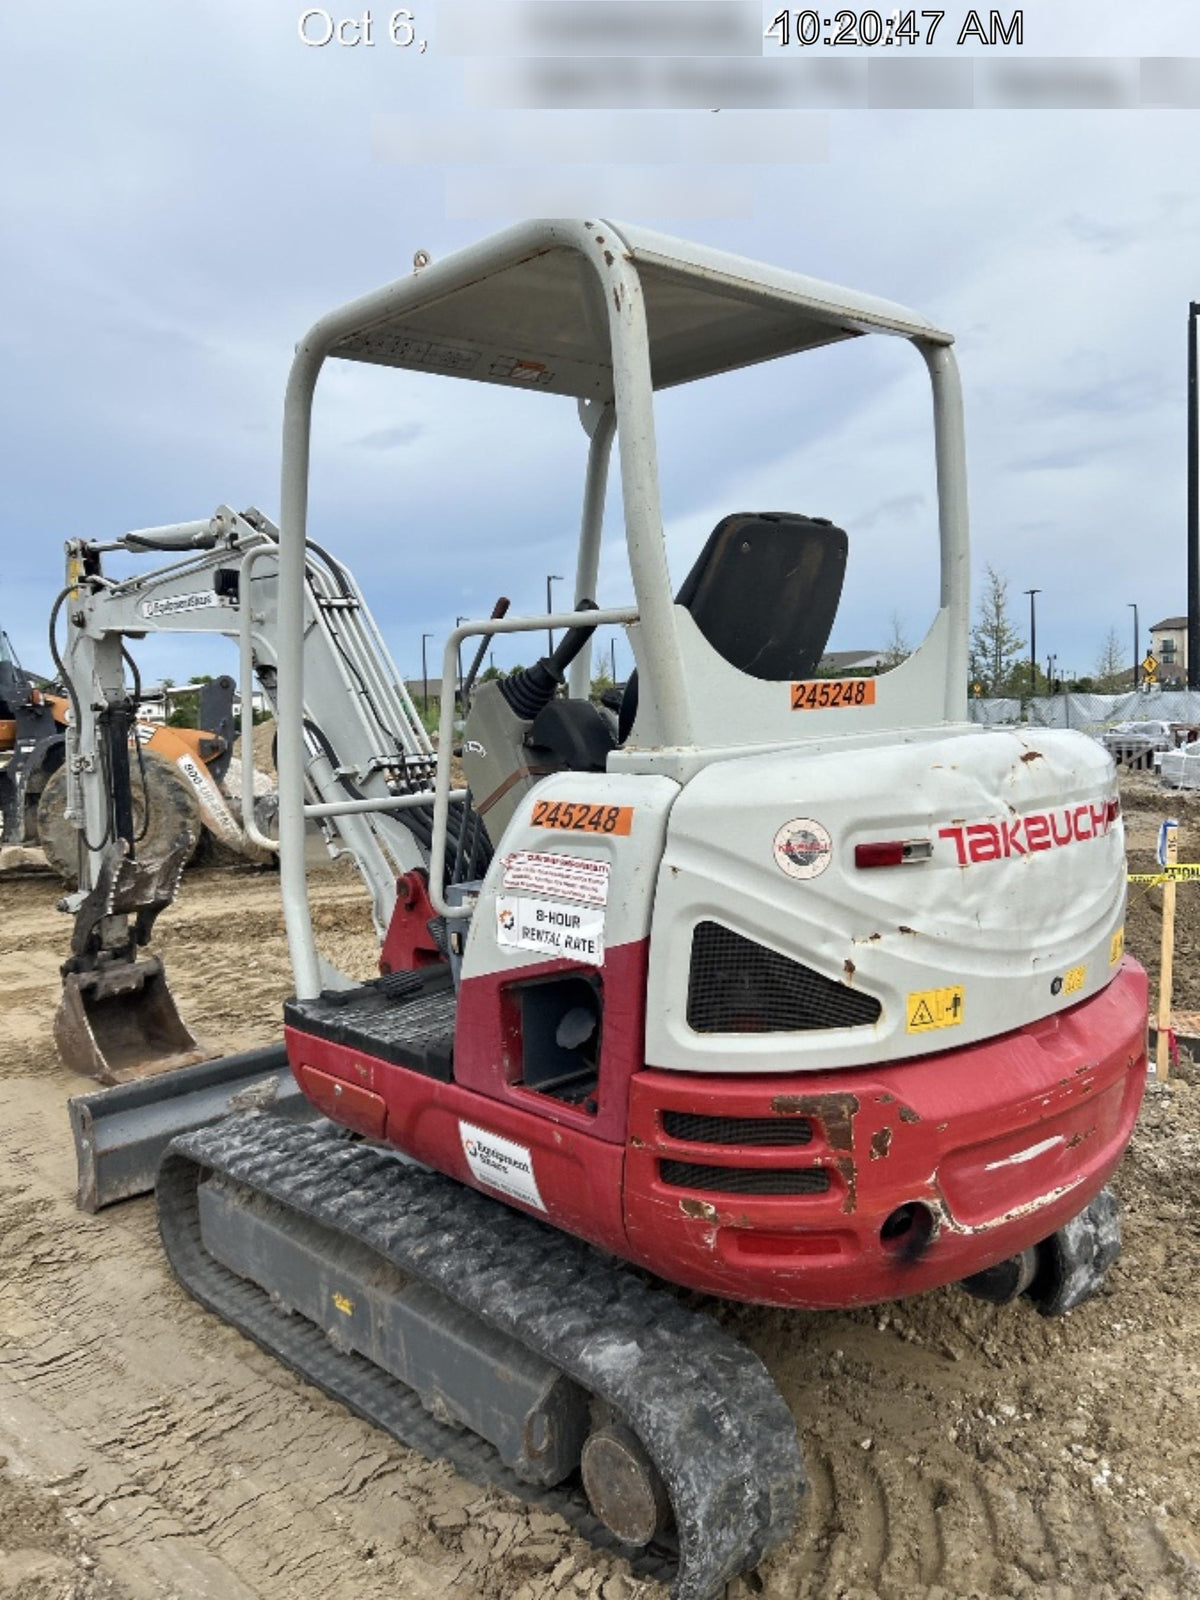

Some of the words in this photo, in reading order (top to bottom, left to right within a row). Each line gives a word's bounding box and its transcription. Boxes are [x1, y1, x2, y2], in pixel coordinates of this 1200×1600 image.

[793, 681, 866, 708] 245248
[531, 801, 619, 832] 245248
[938, 799, 1111, 865] TAKEUCH
[536, 909, 581, 929] 8-HOUR
[522, 926, 561, 947] RENTAL
[564, 935, 595, 954] RATE
